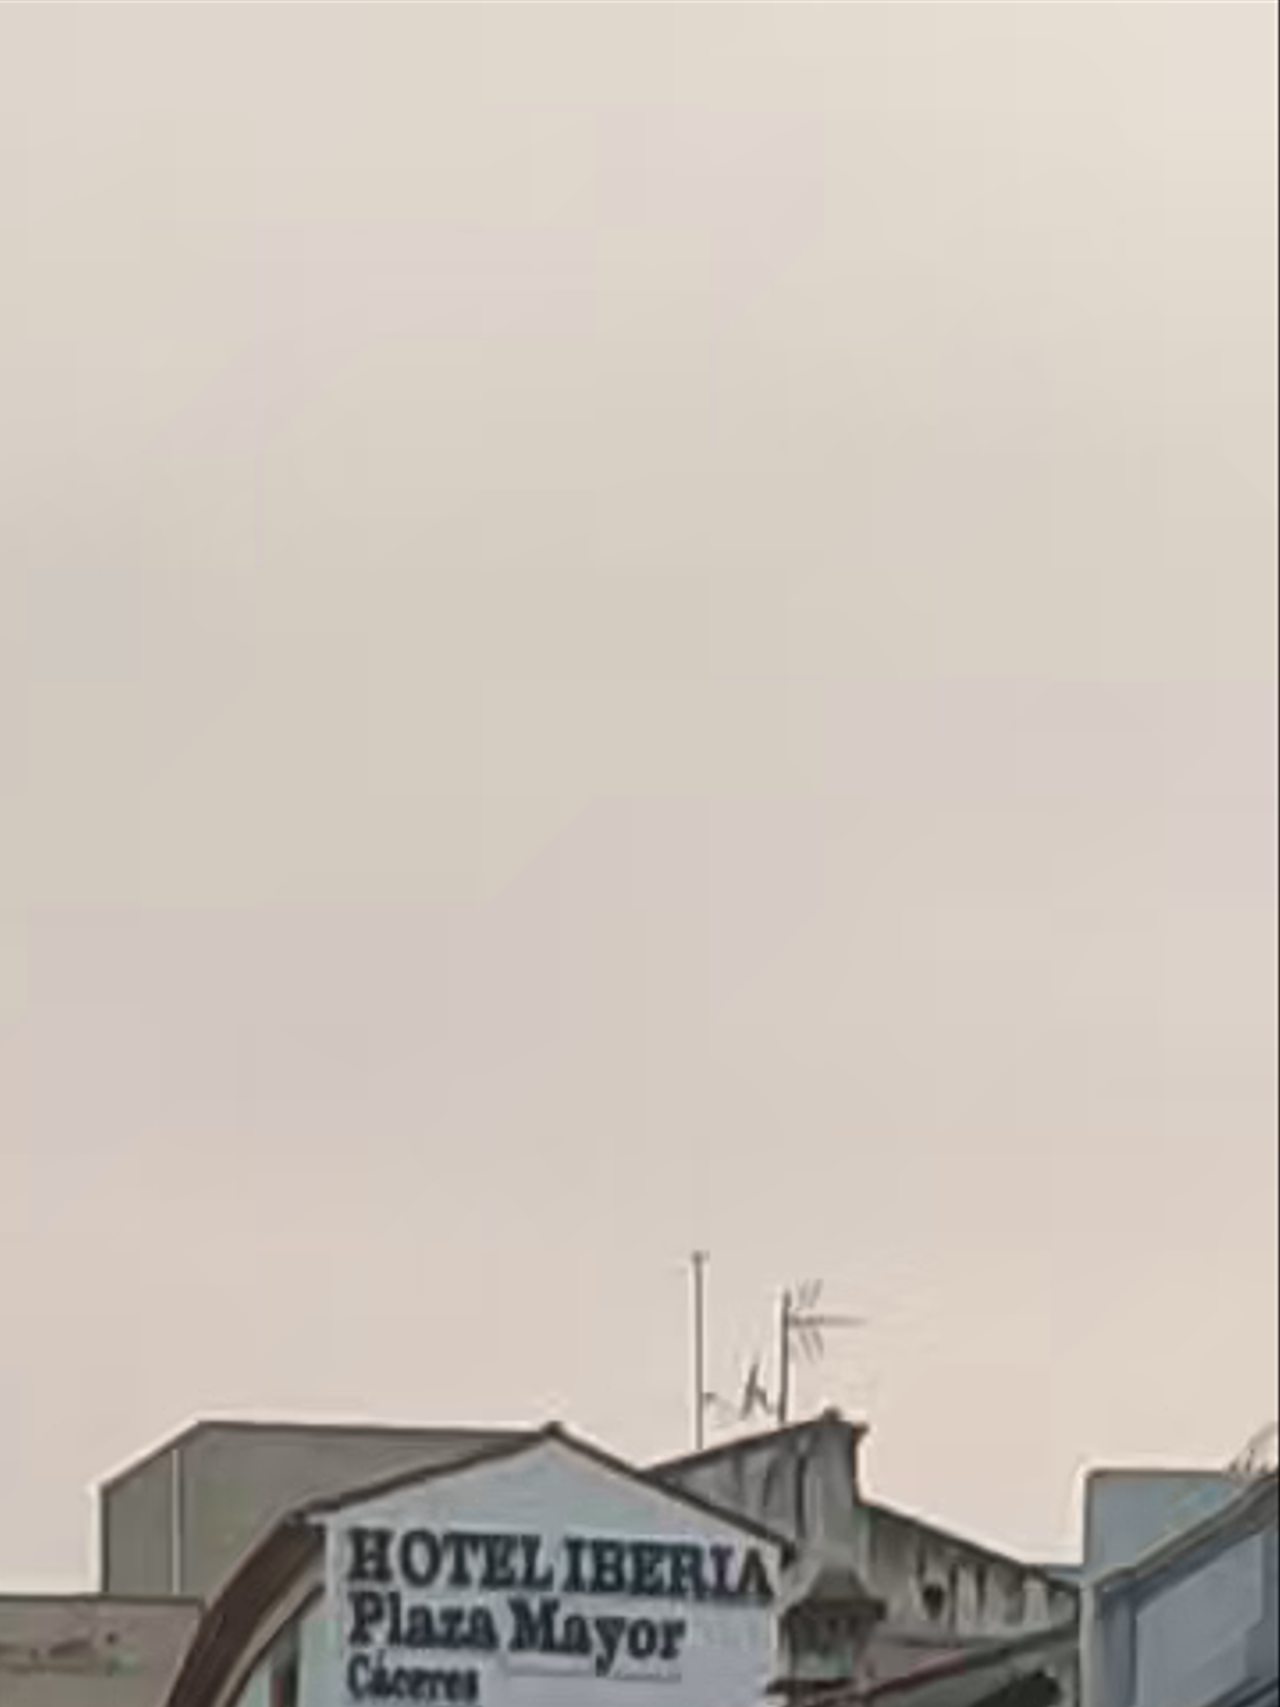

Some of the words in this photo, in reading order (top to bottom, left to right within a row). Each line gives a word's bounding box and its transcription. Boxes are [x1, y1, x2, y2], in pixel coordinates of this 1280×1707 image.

[348, 1527, 554, 1588] HOTEL
[563, 1536, 775, 1601] IBERIA
[348, 1591, 498, 1649] Plaza
[507, 1597, 686, 1677] Mayor
